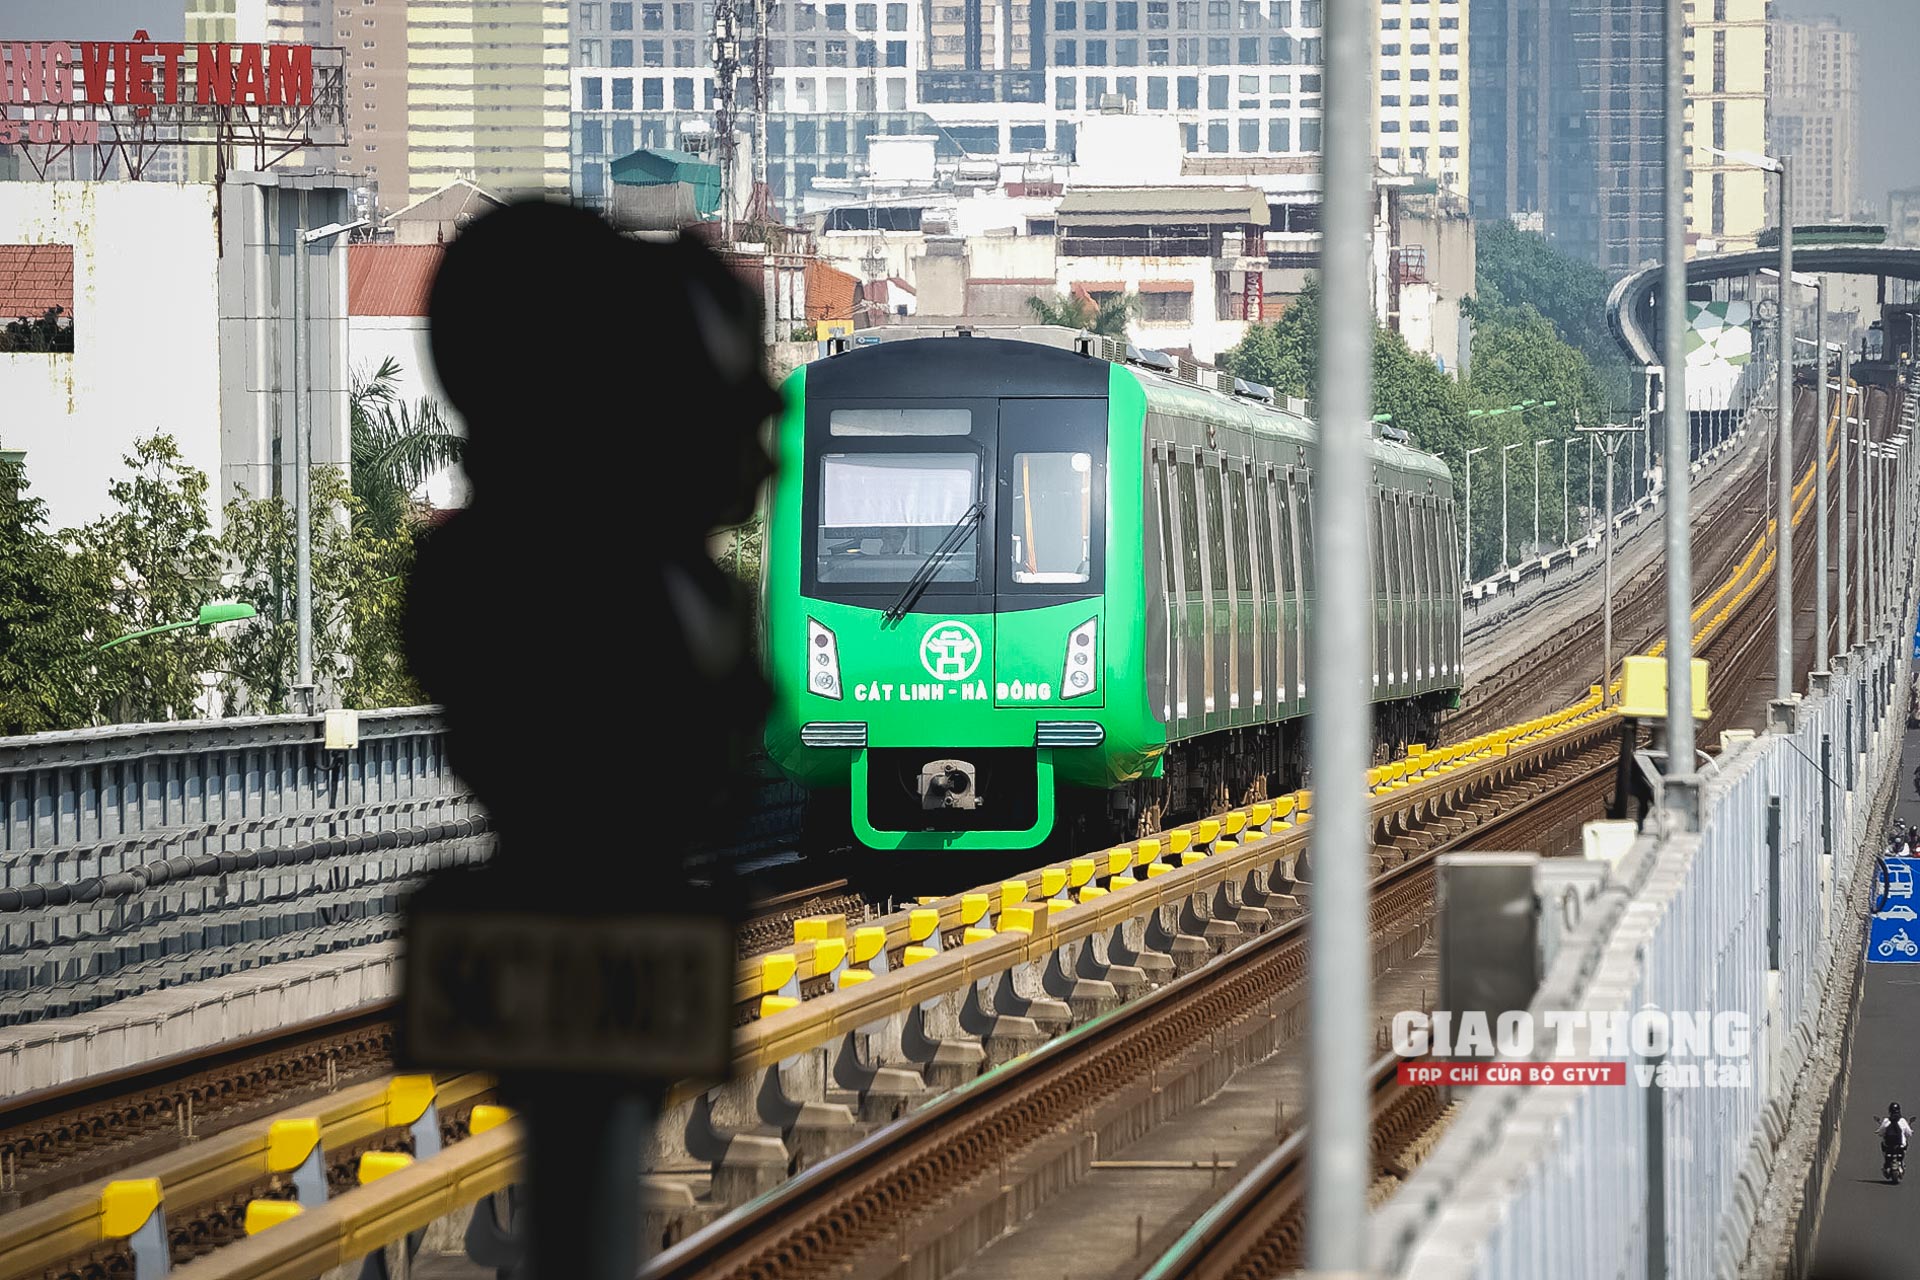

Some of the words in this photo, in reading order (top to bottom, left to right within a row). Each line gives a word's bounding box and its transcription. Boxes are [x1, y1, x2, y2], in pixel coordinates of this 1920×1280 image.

[80, 30, 184, 117] VIỆT
[197, 42, 312, 105] NAM
[854, 681, 893, 701] CÁT
[900, 684, 944, 701] LINH
[961, 680, 988, 701] HÀ
[996, 679, 1051, 701] ĐÔNG
